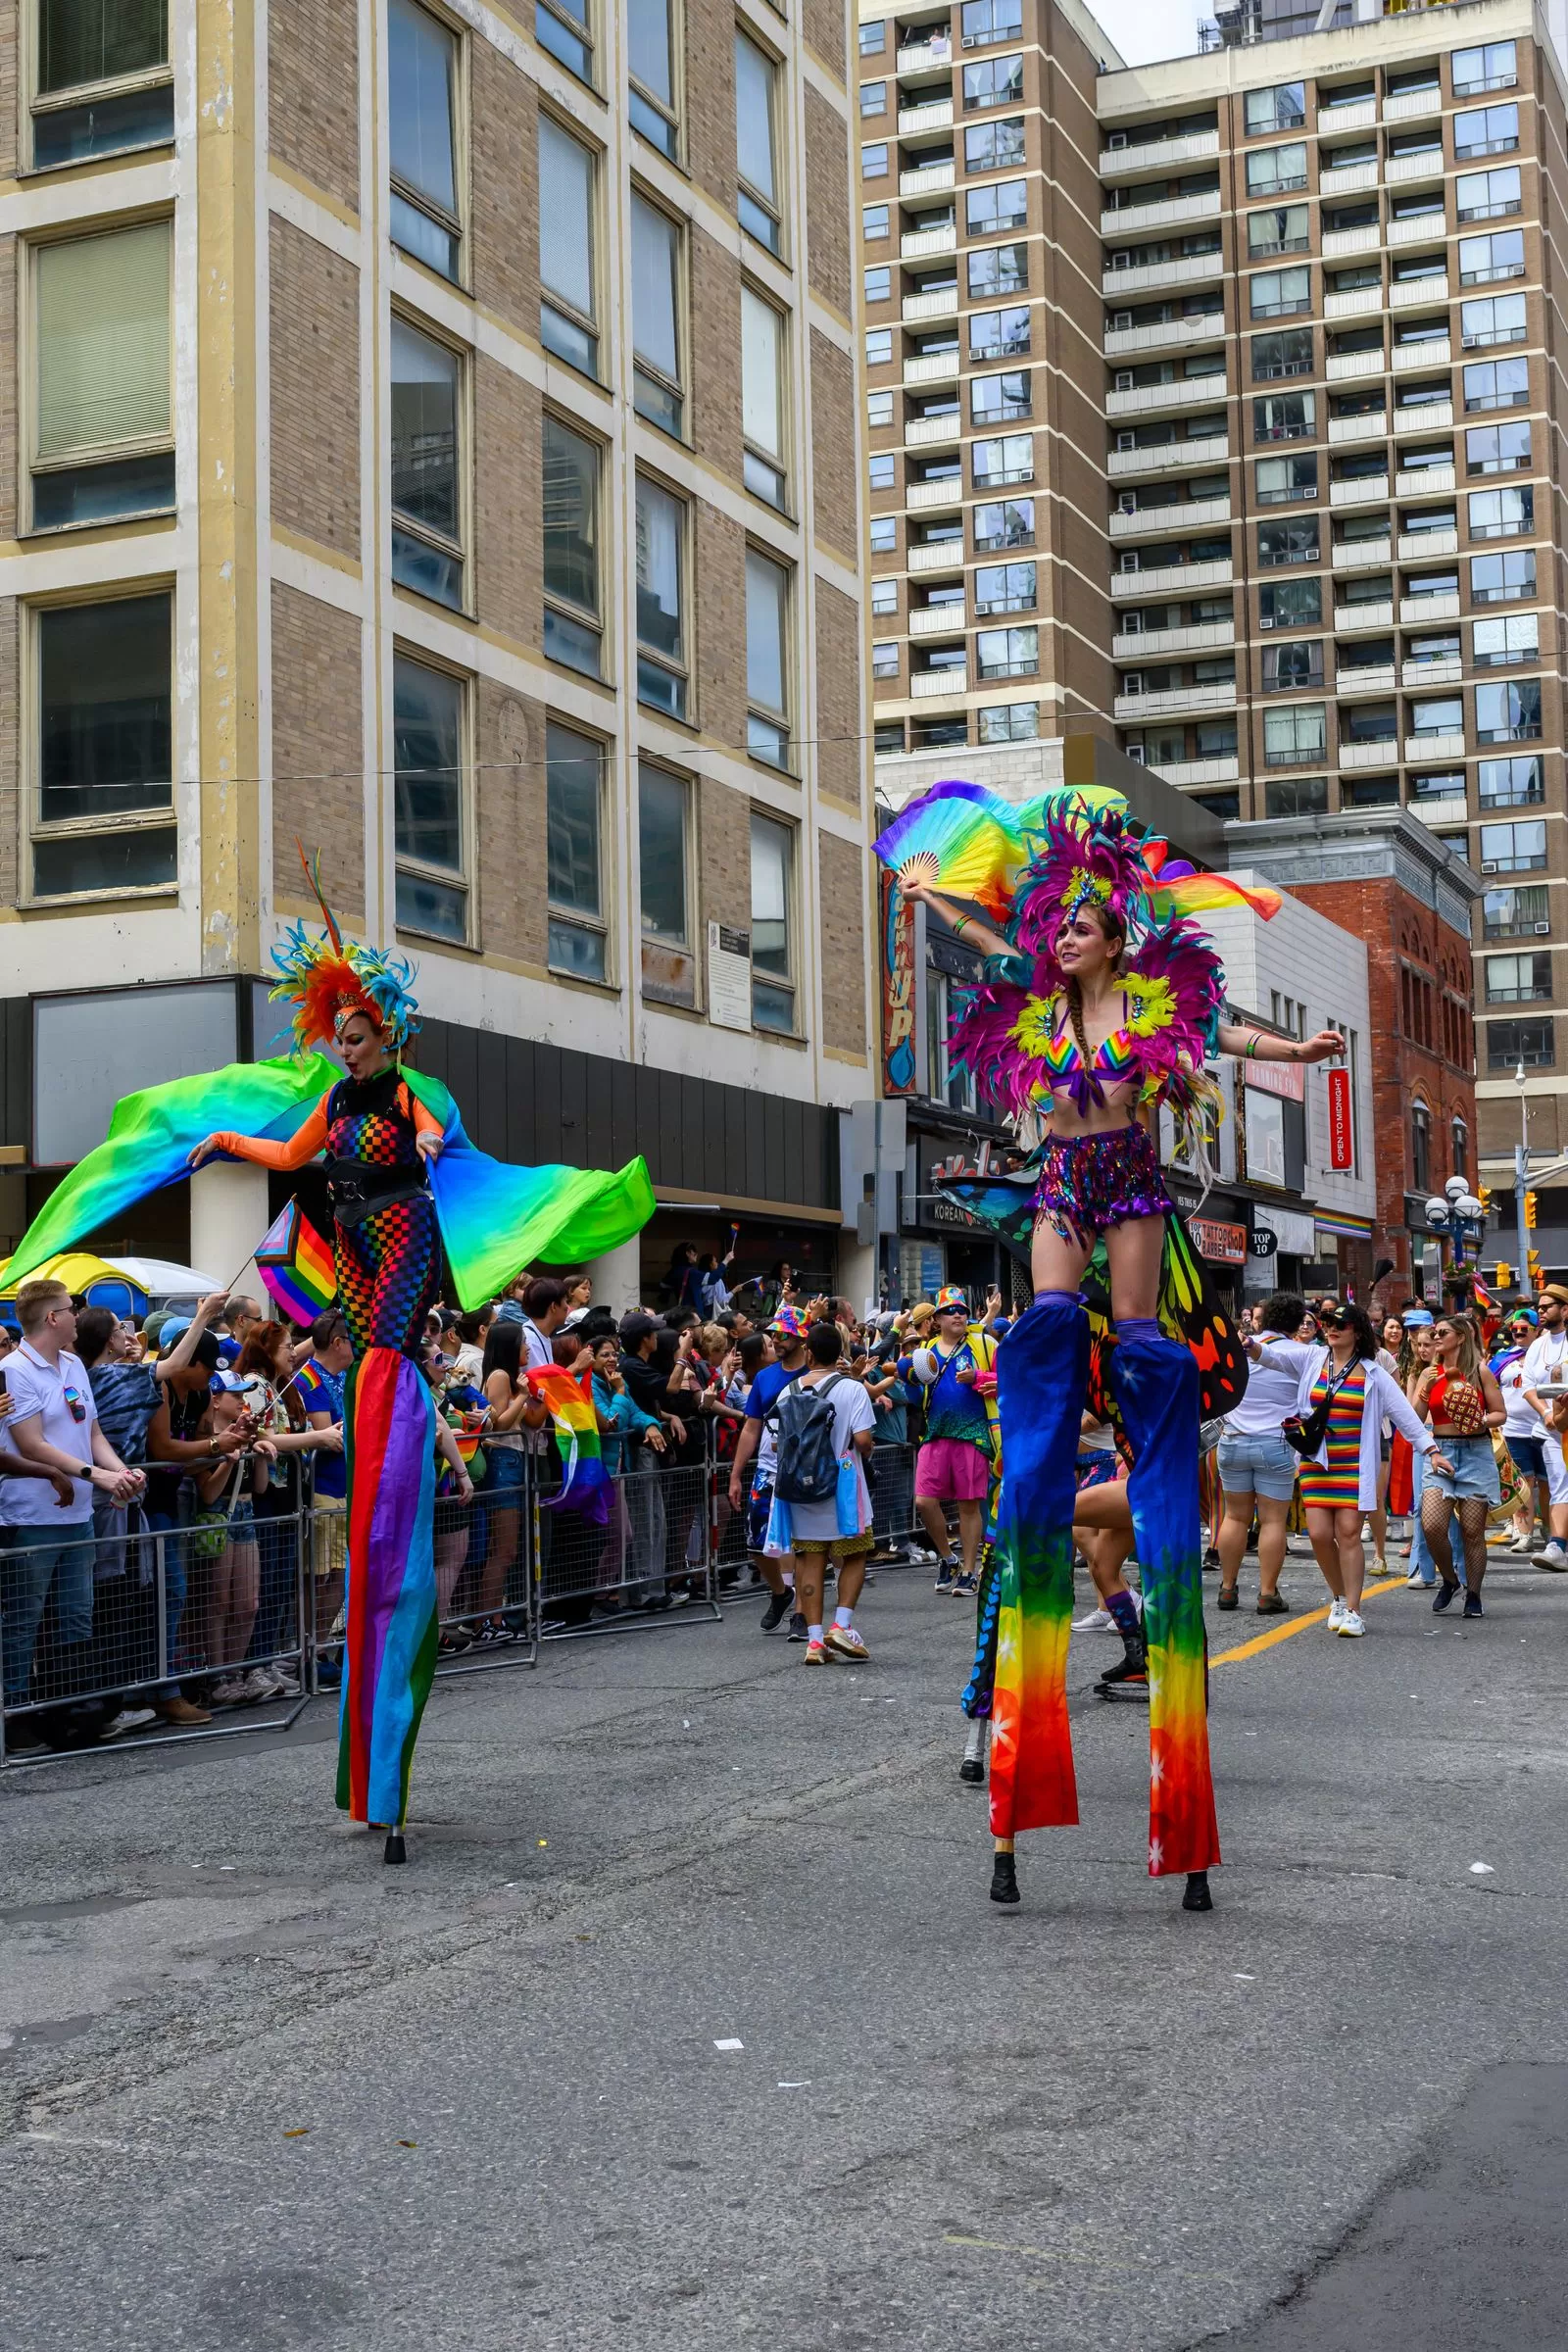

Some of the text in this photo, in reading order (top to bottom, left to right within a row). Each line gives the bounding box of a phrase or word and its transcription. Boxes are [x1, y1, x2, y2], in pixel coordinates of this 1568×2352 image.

[1337, 1122, 1344, 1135] TO
[1184, 1198, 1193, 1208] THIS
[934, 1204, 964, 1222] KOREAN
[1191, 1222, 1201, 1232] TOP
[1202, 1223, 1228, 1242] TATTOO
[1251, 1233, 1271, 1244] TOP
[1255, 1245, 1268, 1254] 10
